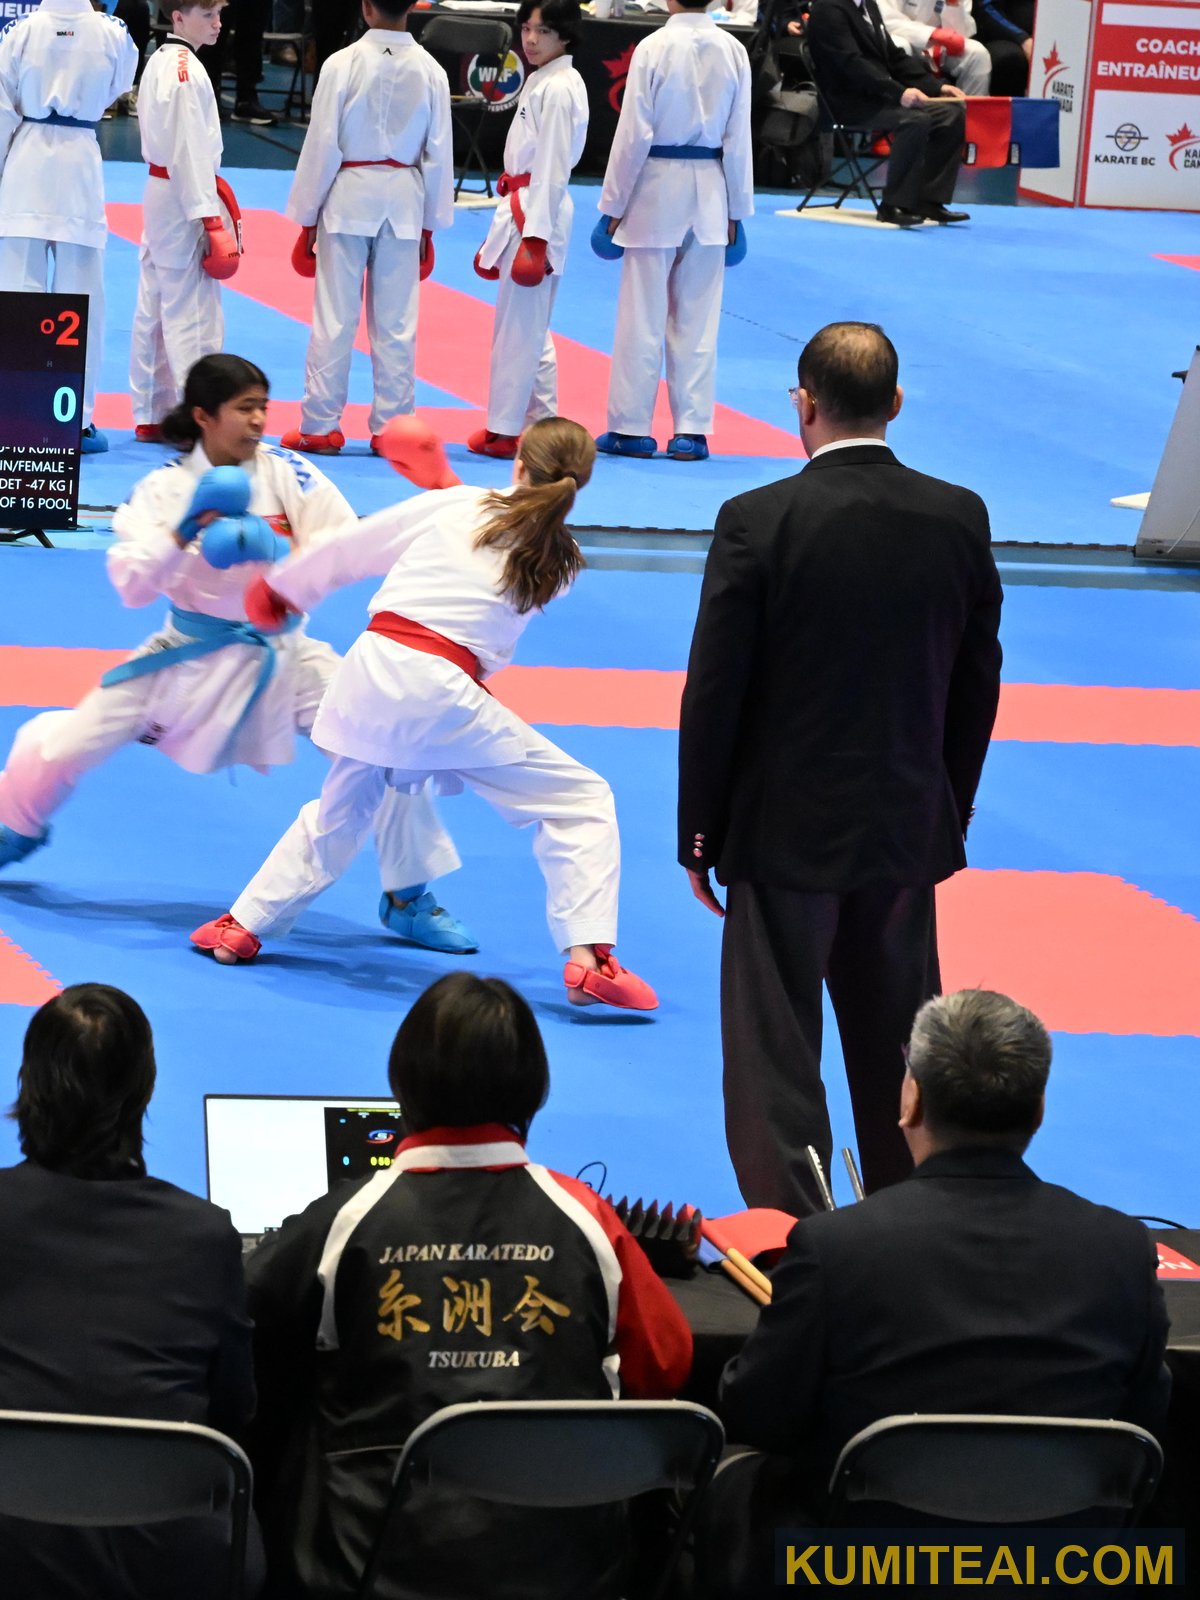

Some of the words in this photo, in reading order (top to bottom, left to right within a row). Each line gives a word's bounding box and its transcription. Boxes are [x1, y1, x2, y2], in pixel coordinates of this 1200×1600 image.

[1094, 154, 1138, 165] KARATE
[1141, 156, 1156, 167] BC
[55, 310, 81, 346] 2
[53, 386, 77, 423] 0
[25, 479, 45, 491] -47
[49, 480, 66, 491] KG
[0, 497, 17, 508] OF
[20, 497, 35, 509] 16
[38, 498, 72, 510] POOL
[379, 1244, 447, 1264] JAPAN
[448, 1243, 555, 1262] KARATEDO
[428, 1350, 520, 1368] TSUKUBA
